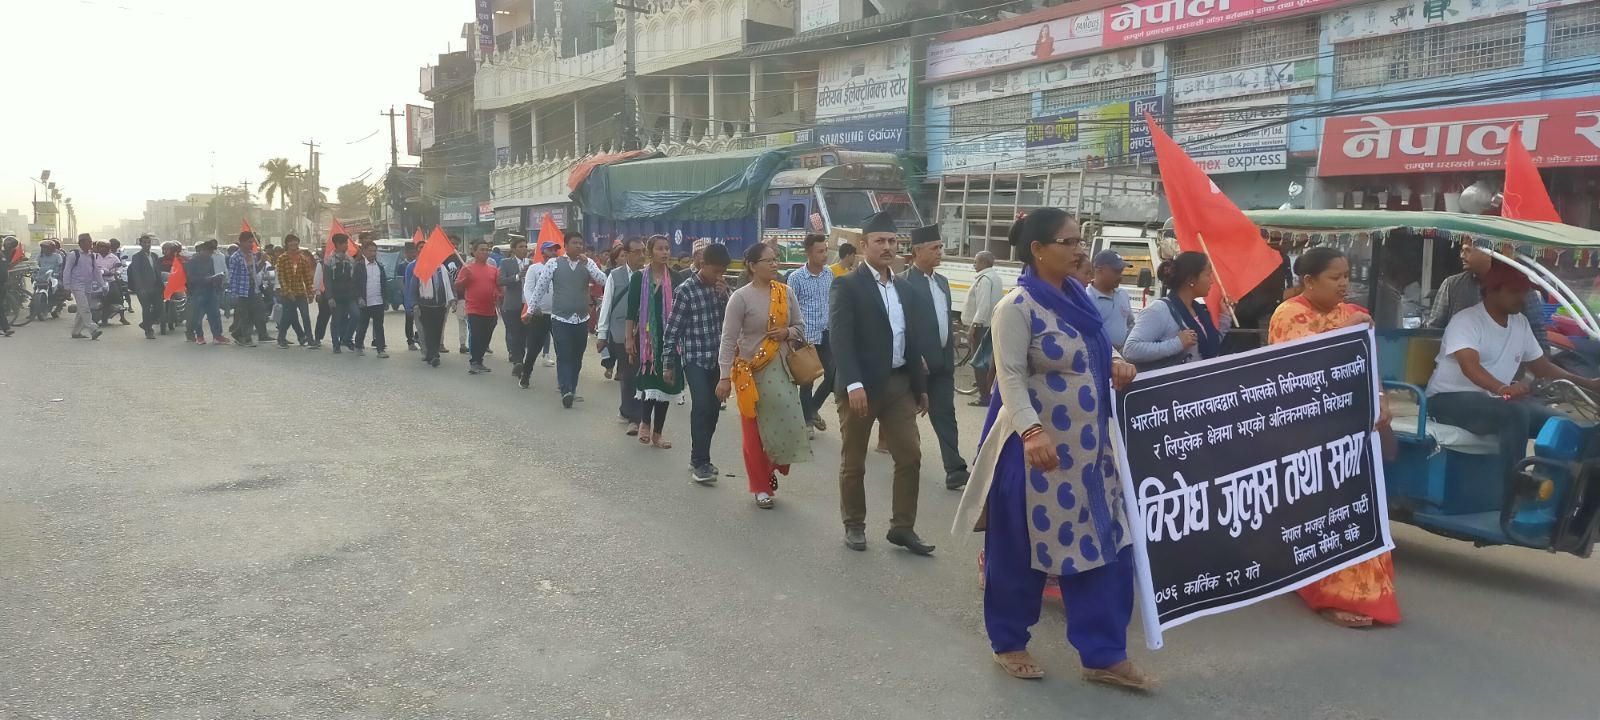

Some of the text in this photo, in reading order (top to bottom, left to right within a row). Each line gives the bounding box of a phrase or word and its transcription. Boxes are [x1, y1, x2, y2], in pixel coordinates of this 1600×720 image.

[1110, 0, 1231, 32] नेपाल
[890, 73, 907, 98] स्टोर
[819, 130, 864, 145] SAMSUNG
[868, 128, 903, 142] Galaxy
[1261, 128, 1271, 137] (P)
[1271, 126, 1284, 135] Ltd.
[1343, 115, 1549, 159] नेपाल
[1195, 153, 1281, 171] mex express
[1131, 356, 1366, 432] भारतीय विस्तारवादद्वारा नेपालको लिम्पियाधुरा, कालापानी
[1154, 391, 1352, 460] र लिपुलेक क्षेत्रमा भएको अतिक्रमणको विरोधमा
[1139, 431, 1366, 543] विरोध जुलुस तथा सभा
[1282, 526, 1301, 543] नेपाल
[1329, 503, 1350, 525] किसान
[1354, 494, 1368, 517] पार्टी
[1294, 523, 1360, 565] जिल्ला समिति, बाँके
[1184, 574, 1220, 596] कार्तिक
[1226, 571, 1240, 586] २२
[1246, 561, 1260, 582] गते
